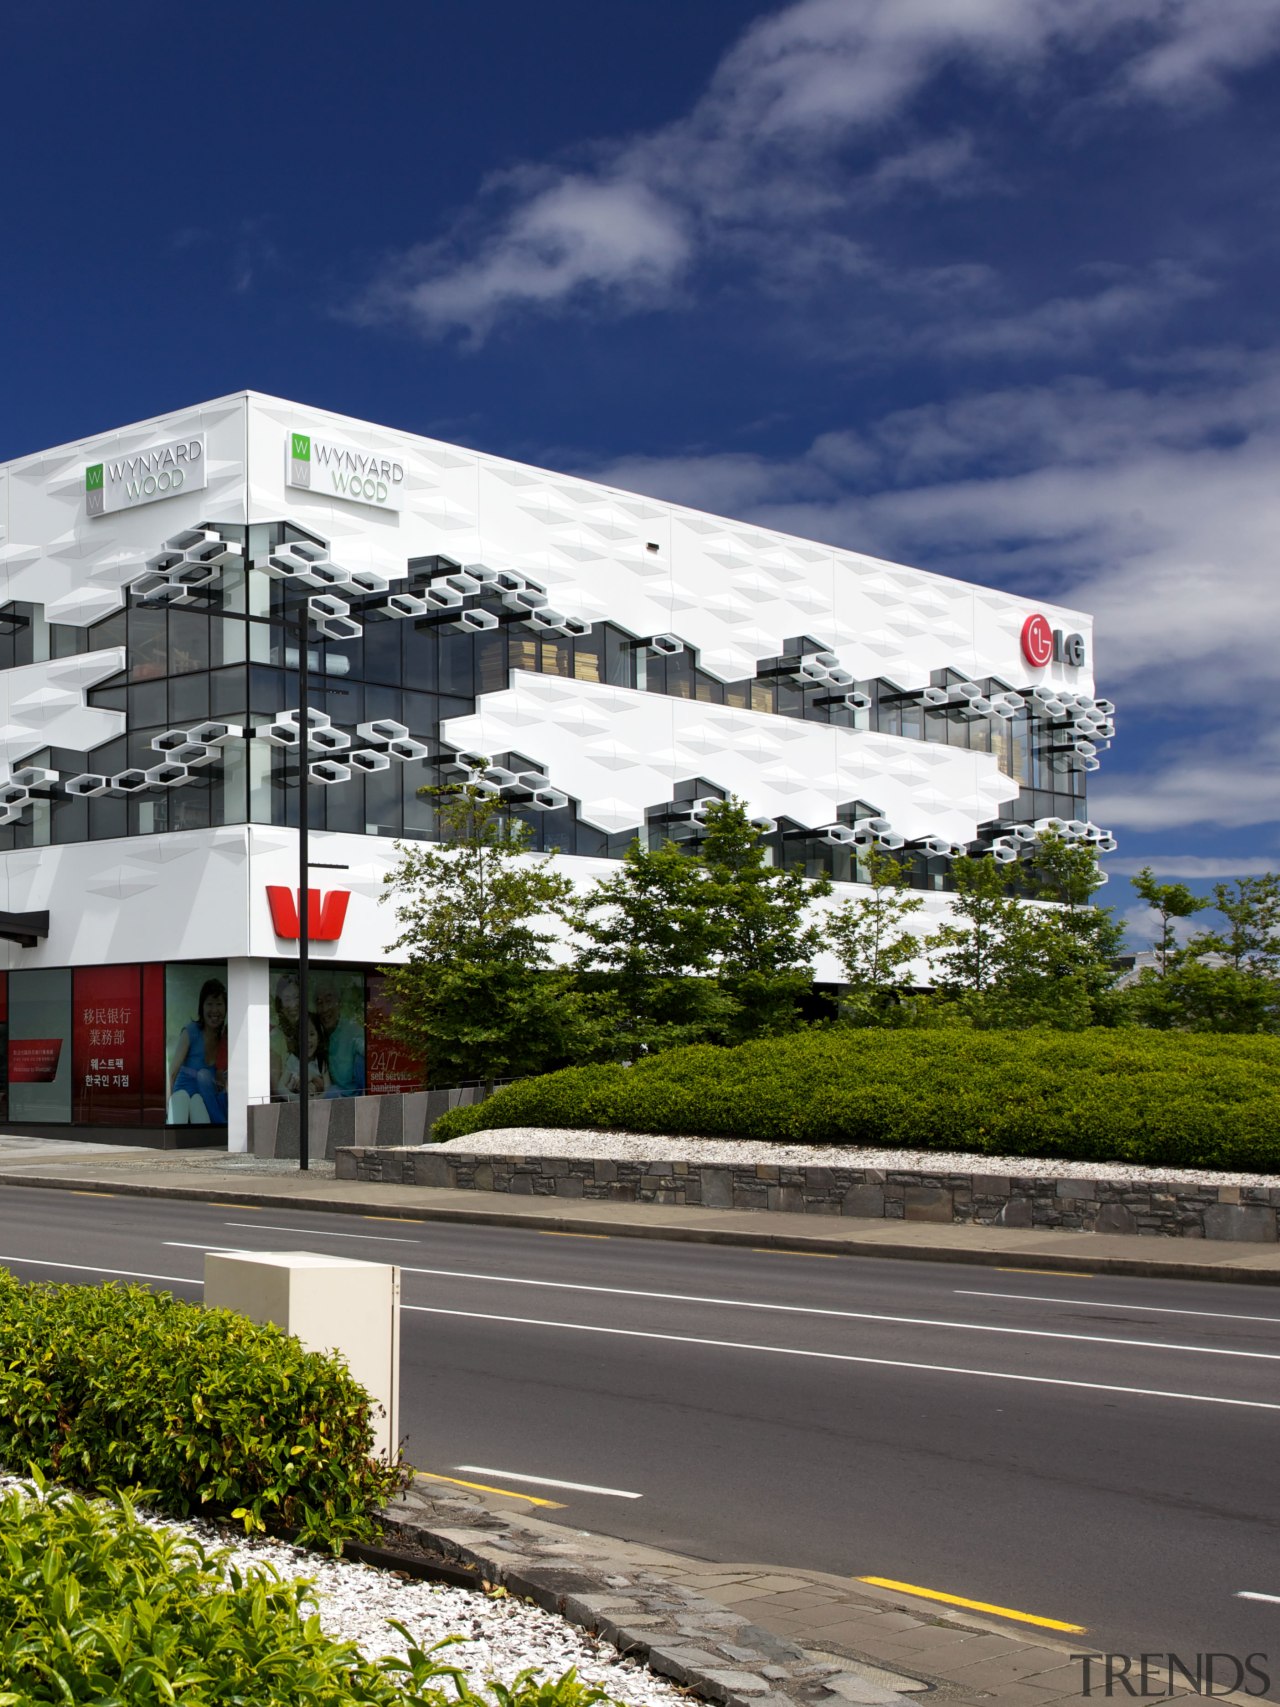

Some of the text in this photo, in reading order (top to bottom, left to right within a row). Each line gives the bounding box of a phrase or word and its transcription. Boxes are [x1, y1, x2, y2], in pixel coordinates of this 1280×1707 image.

[108, 441, 202, 483] WYNYARD
[315, 443, 404, 483] WYNYARD
[126, 469, 185, 501] WOOD
[332, 470, 389, 503] WOOD
[1053, 630, 1085, 667] LG
[89, 1029, 125, 1046] 業務部
[91, 1058, 124, 1071] 웨스트팩
[370, 1051, 398, 1072] 24/7
[85, 1074, 130, 1087] 한국인 지점
[370, 1071, 384, 1081] self
[370, 1082, 401, 1094] banking
